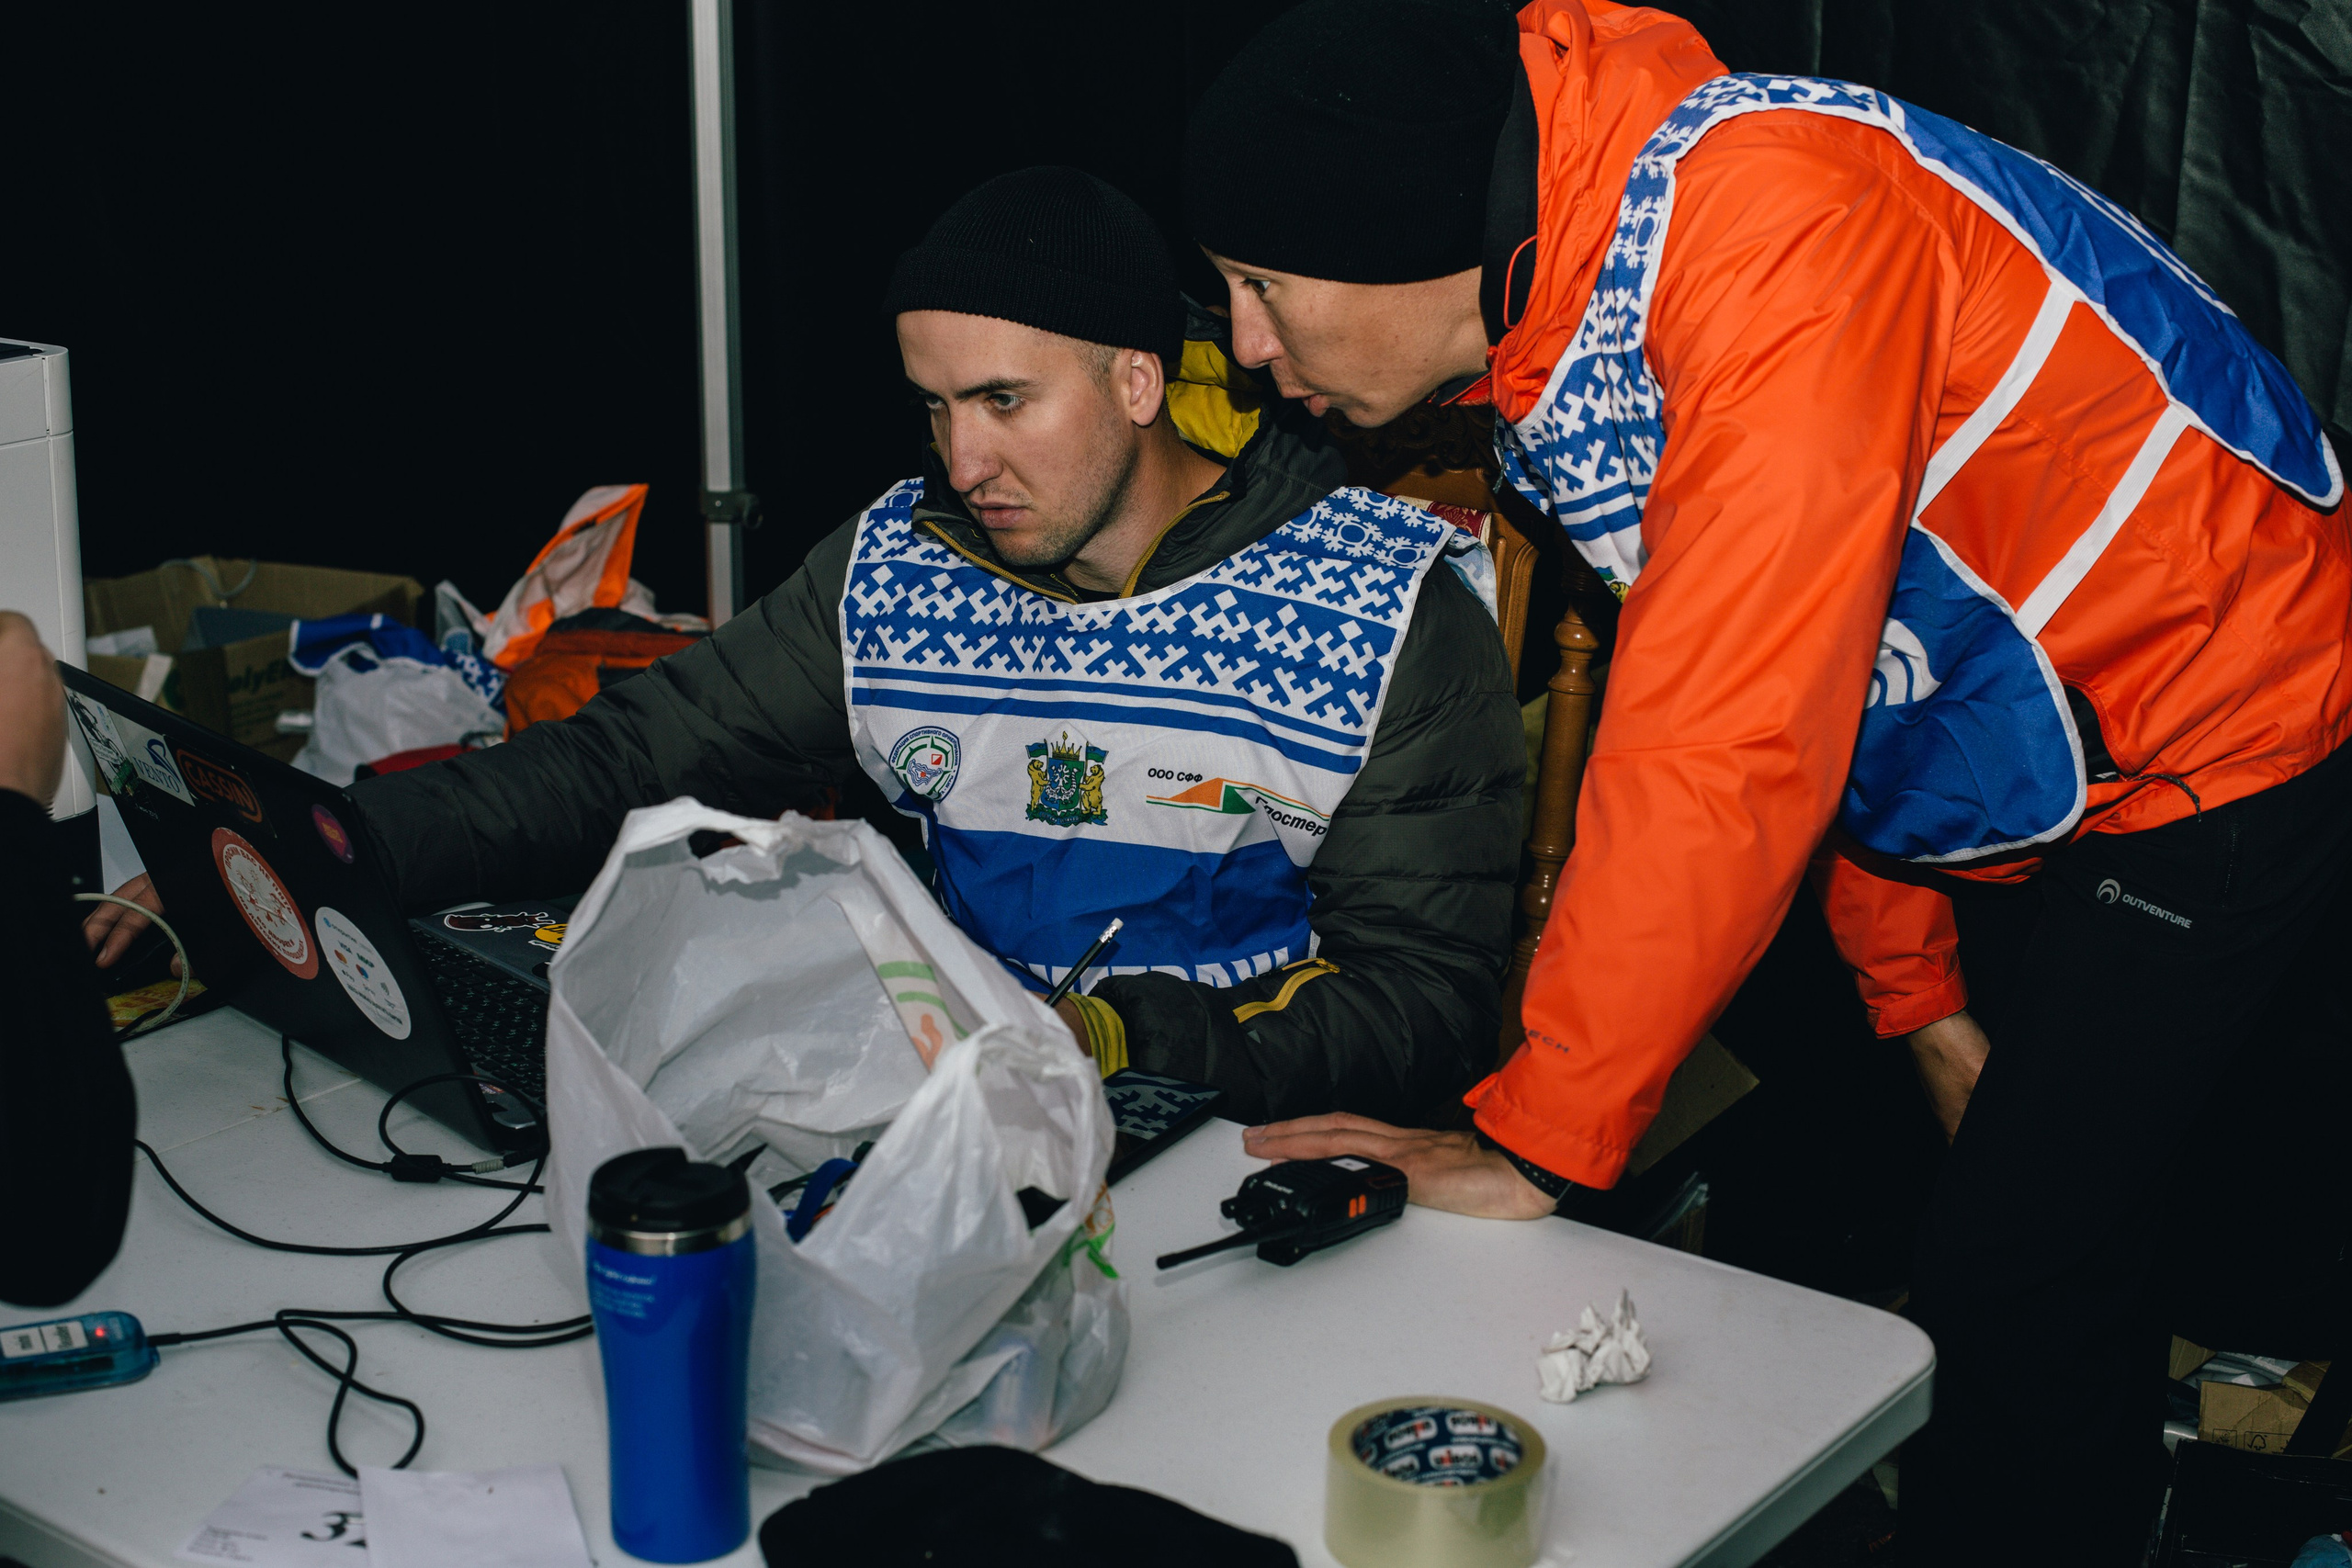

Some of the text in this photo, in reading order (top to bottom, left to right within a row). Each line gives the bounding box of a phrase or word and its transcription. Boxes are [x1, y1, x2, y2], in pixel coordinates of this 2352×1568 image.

[891, 737, 910, 764] ФЕДЕРАЦИЯ
[909, 728, 942, 739] СПОРТИВНОГО
[131, 755, 181, 794] VENTO
[185, 761, 256, 813] CASSIN
[1148, 767, 1204, 784] ООО СФФ
[224, 844, 293, 915] ПРОСИМ ВАС НЕ ПИТЬ
[2122, 893, 2193, 930] OUTVENTURE
